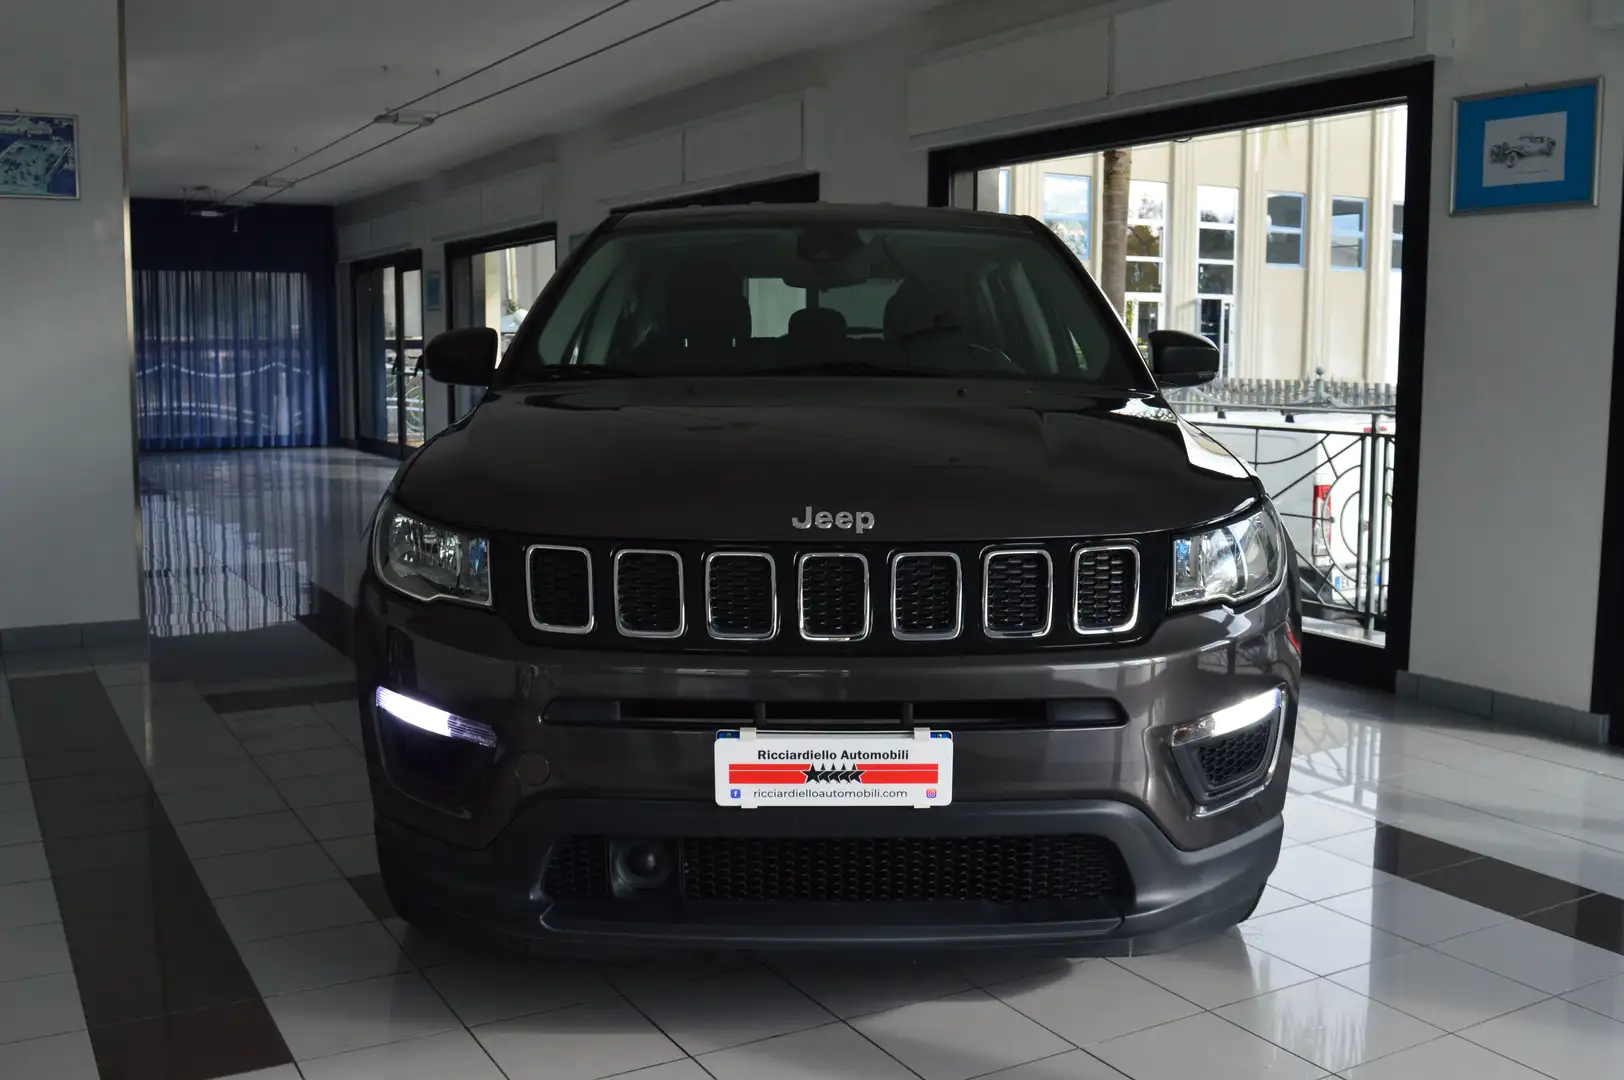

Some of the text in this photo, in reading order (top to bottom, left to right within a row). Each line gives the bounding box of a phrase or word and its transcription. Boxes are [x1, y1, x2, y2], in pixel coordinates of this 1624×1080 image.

[791, 505, 875, 534] Jeep
[757, 749, 909, 760] Ricciardiello Automobili
[753, 788, 908, 799] ricciardielloautomobili.com
